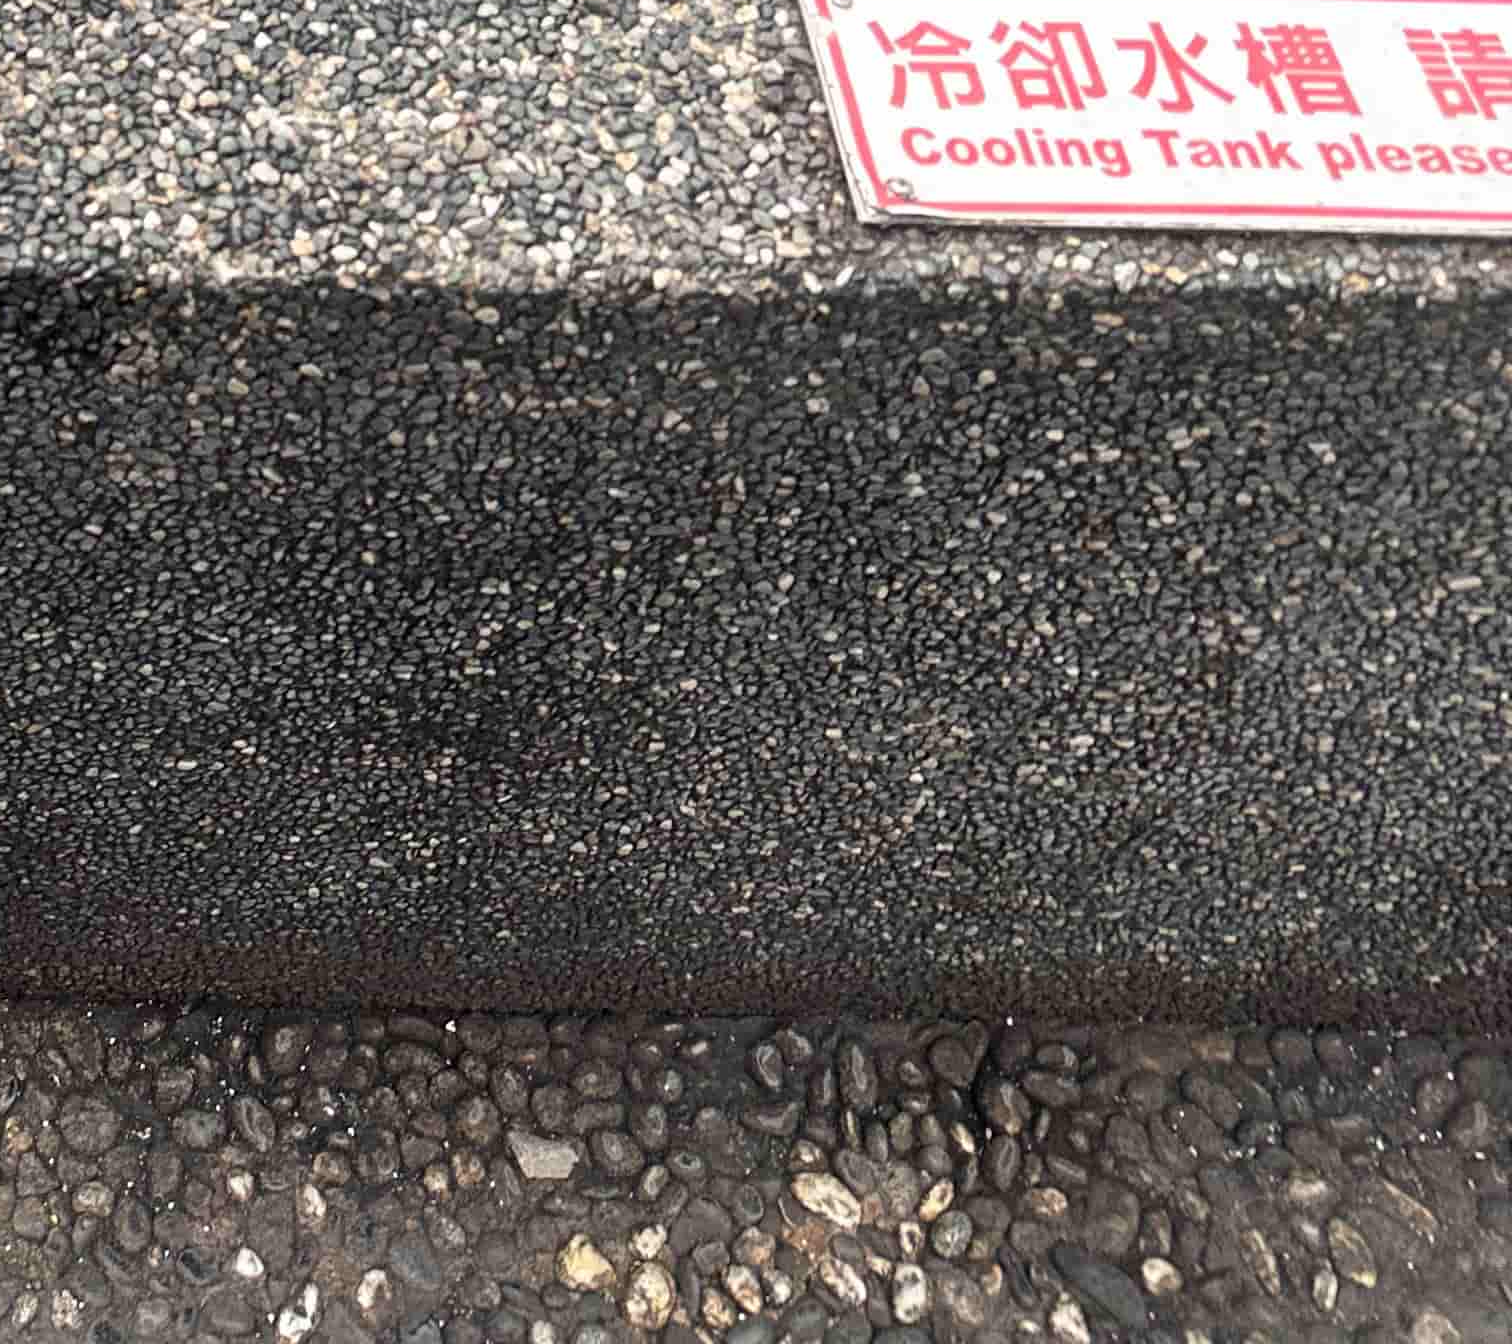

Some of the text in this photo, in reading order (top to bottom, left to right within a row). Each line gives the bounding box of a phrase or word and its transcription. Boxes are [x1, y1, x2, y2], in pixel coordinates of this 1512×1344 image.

[867, 20, 1512, 120] 冷卻水槽 請
[900, 126, 1512, 182] Cooling Tank please
